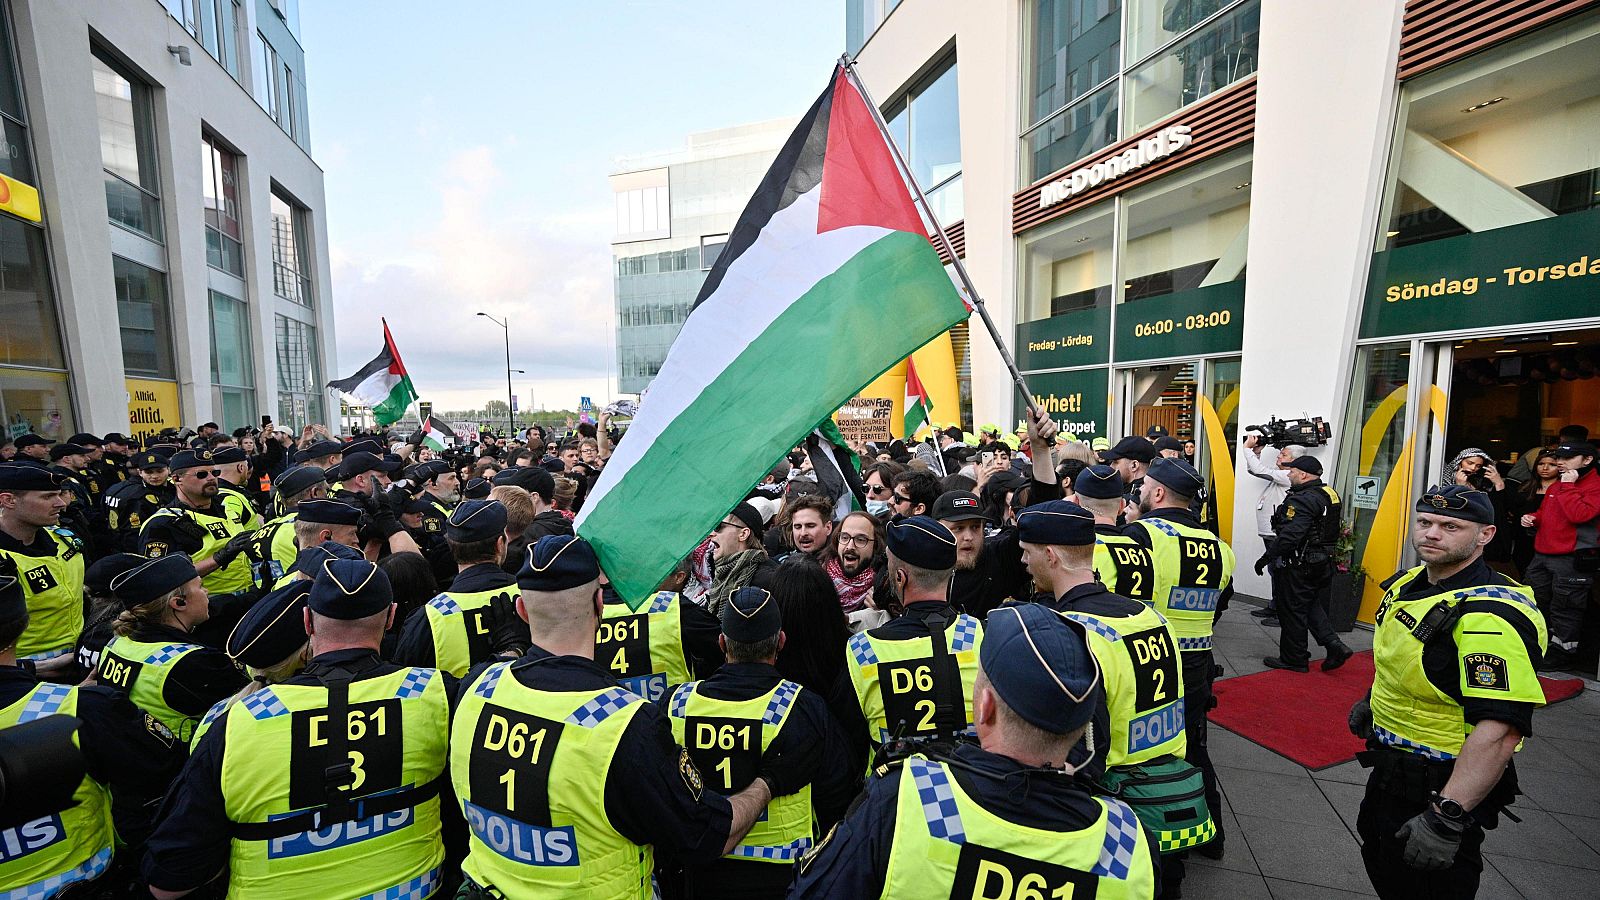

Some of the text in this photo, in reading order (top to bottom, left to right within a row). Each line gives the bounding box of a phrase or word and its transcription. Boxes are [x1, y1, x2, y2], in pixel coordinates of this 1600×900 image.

[1039, 124, 1193, 209] McDonald's
[1386, 277, 1479, 303] Söndag
[1135, 318, 1173, 338] 06:00
[1185, 310, 1231, 331] 03:00
[1029, 340, 1056, 352] Fredag
[1062, 334, 1093, 347] Lördag
[134, 390, 157, 403] Alltid,
[130, 407, 164, 425] alltid,
[873, 408, 891, 418] OFF
[1063, 419, 1095, 435] öppet
[208, 523, 224, 531] D61
[1114, 547, 1148, 567] D61
[1185, 540, 1216, 560] D61
[28, 567, 47, 580] D61
[39, 578, 49, 589] 3
[1130, 571, 1143, 596] 2
[1195, 563, 1209, 585] 2
[596, 618, 639, 644] D61
[1397, 611, 1415, 627] POLIS
[610, 646, 630, 674] 4
[1132, 632, 1170, 665] D61
[1467, 655, 1501, 666] POLIS
[102, 657, 132, 687] D61
[890, 665, 933, 694] D6
[1152, 668, 1166, 702] 2
[914, 699, 937, 731] 2
[1131, 701, 1184, 750] POLIS
[484, 713, 547, 765] D61
[696, 722, 750, 750] D61
[715, 756, 732, 789] 1
[499, 768, 516, 812] 1
[467, 805, 573, 864] POLIS
